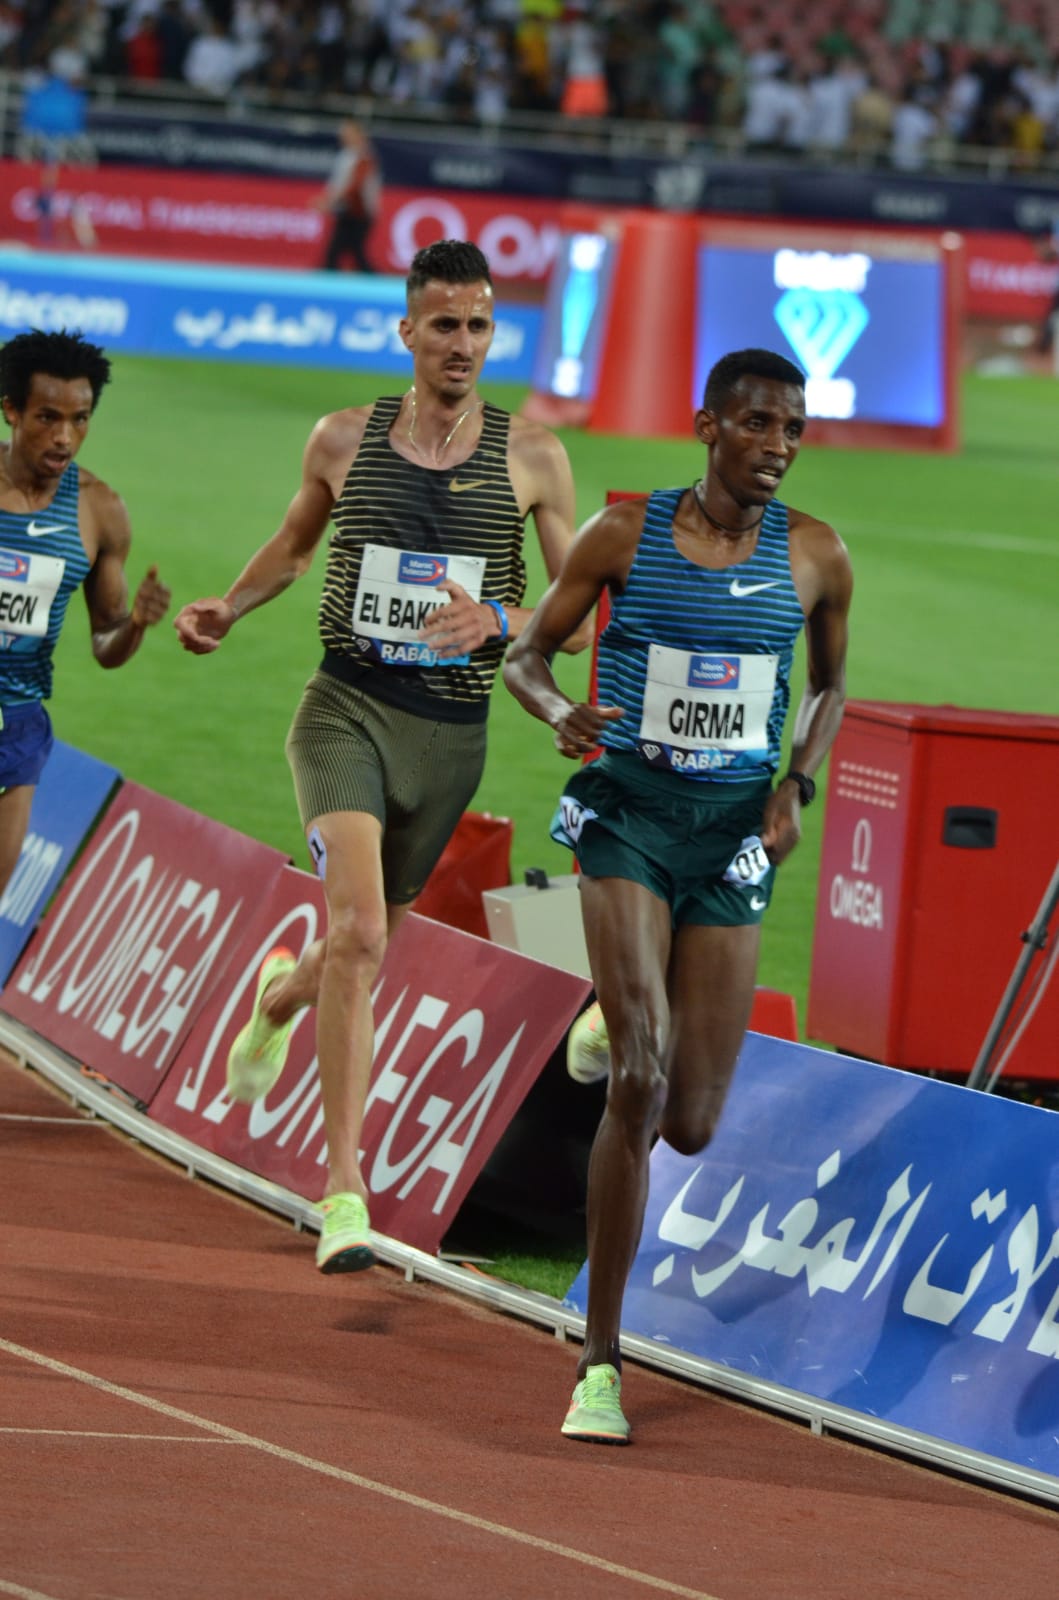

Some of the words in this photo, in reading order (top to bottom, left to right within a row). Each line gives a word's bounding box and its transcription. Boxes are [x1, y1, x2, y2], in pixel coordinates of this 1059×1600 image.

[359, 592, 381, 624] EL
[387, 597, 444, 631] BAK
[668, 698, 745, 739] GIRMA
[670, 750, 736, 770] RABAT
[830, 873, 884, 930] OMEGA
[57, 855, 243, 1069] OMEGA
[652, 1149, 932, 1301] المغرب
